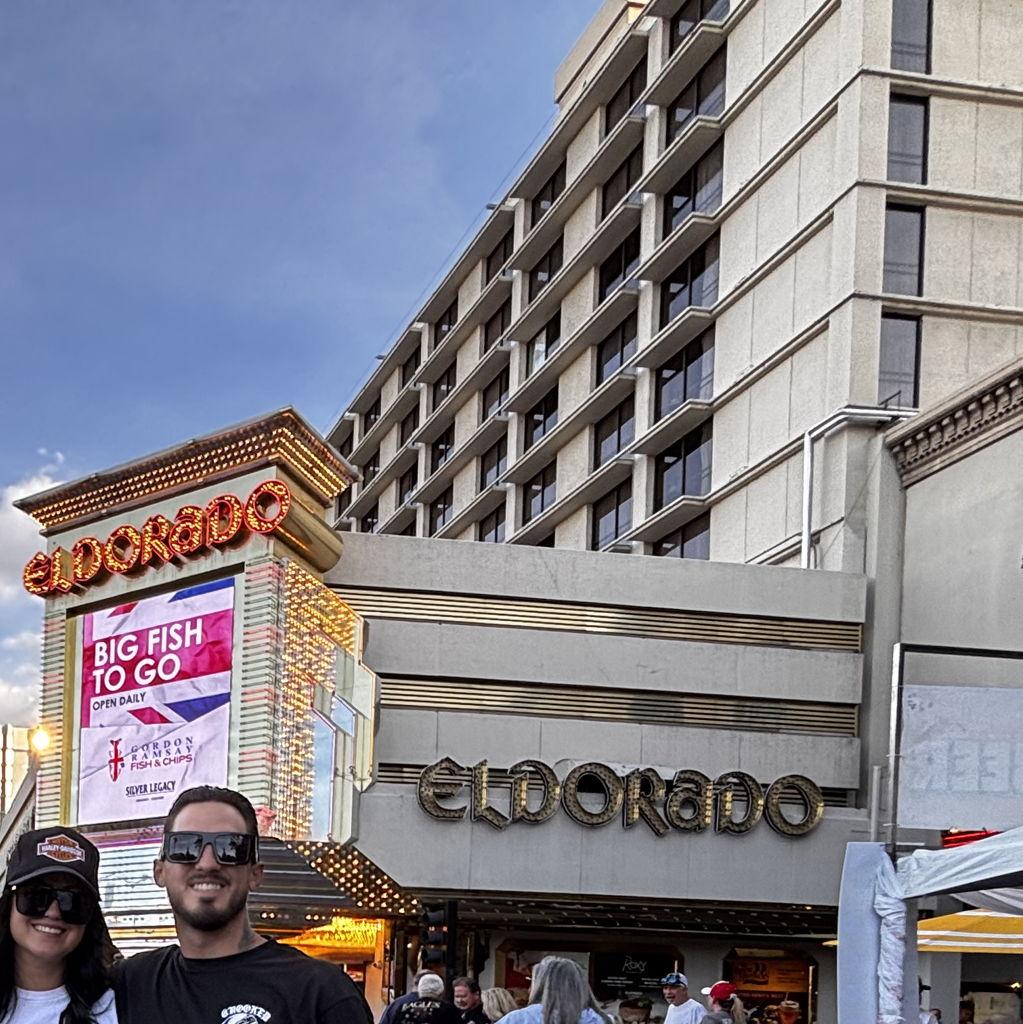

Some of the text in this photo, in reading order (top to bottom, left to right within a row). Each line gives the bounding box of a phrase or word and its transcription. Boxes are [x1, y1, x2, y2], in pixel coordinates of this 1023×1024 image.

[94, 618, 203, 667] BIG FISH
[92, 653, 181, 694] TO GO
[92, 692, 147, 711] OPEN DAILY
[131, 736, 193, 753] GORDON
[132, 745, 193, 761] RAMSAY
[130, 754, 193, 771] FISH & CHIPS
[125, 781, 176, 796] SILVER LEGACY
[221, 1004, 271, 1022] CROOKED
[402, 1001, 441, 1012] EAGLES
